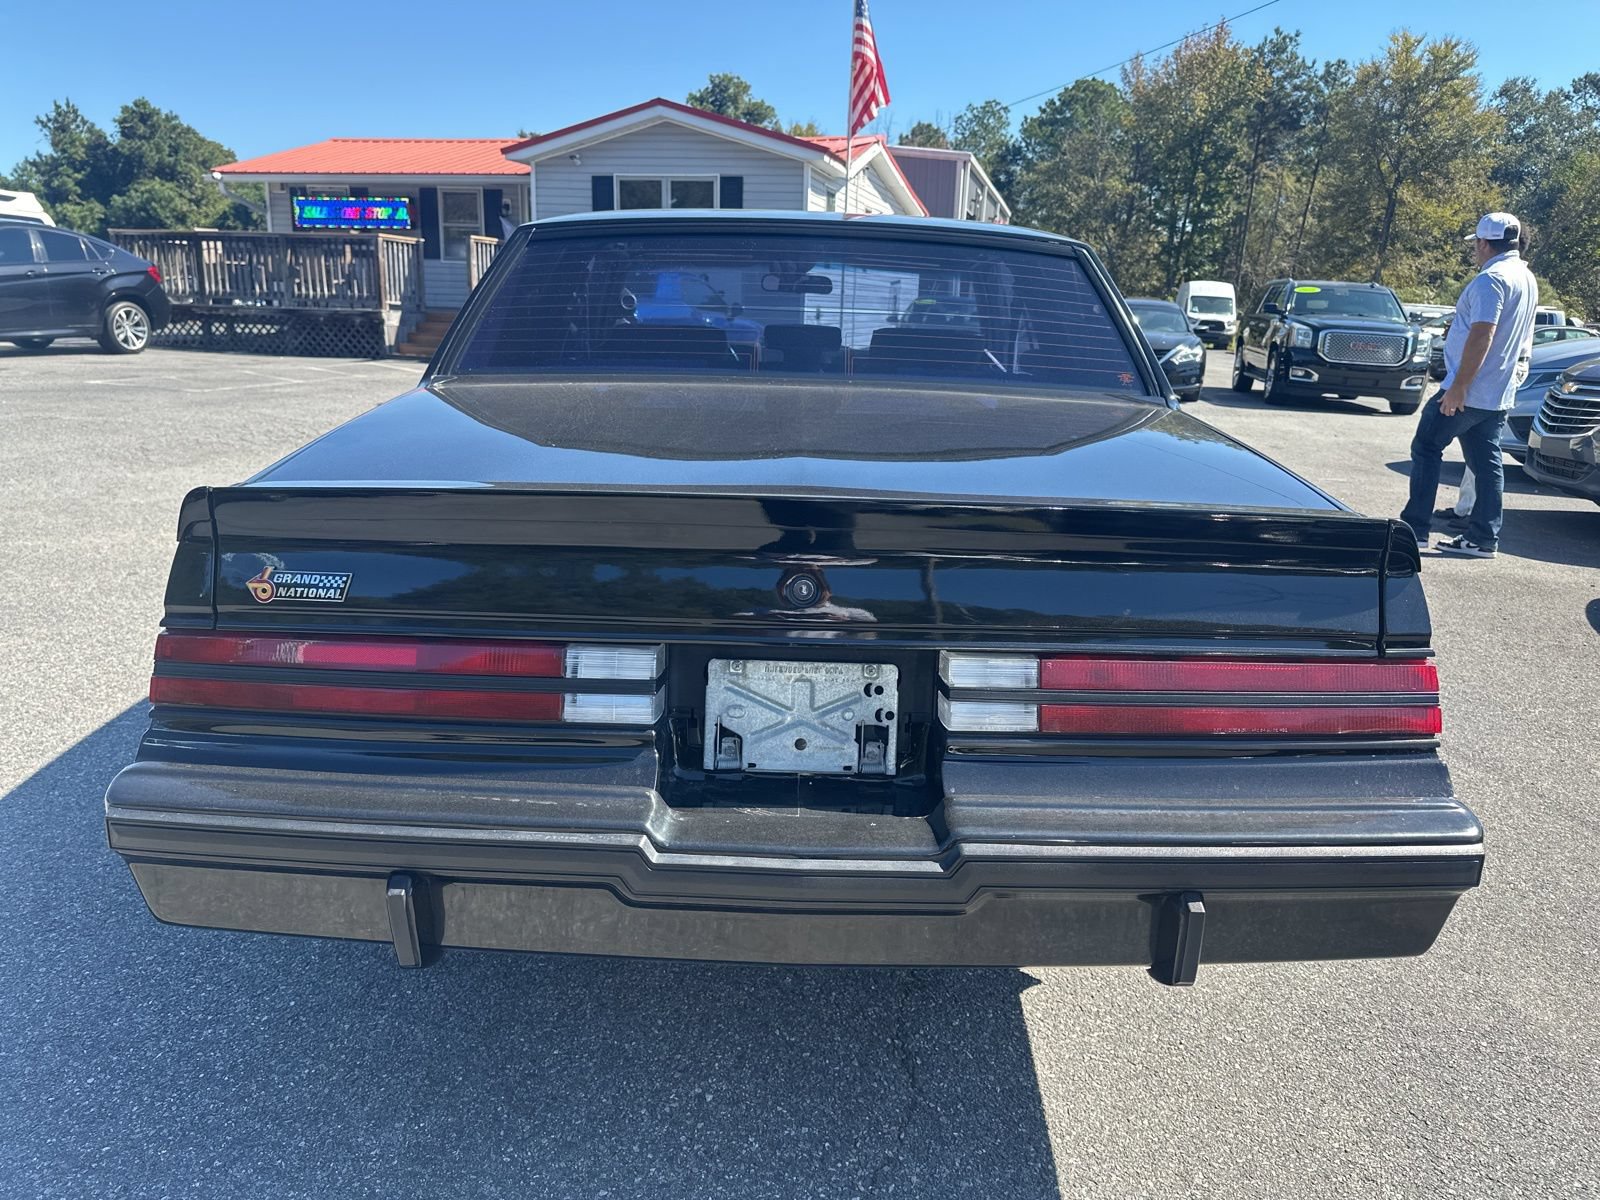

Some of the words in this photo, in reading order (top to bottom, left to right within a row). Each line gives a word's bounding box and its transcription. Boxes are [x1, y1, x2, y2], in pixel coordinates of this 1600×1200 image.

[365, 207, 392, 219] STOP
[273, 573, 320, 584] GRAND
[277, 587, 343, 599] NATIONAL
